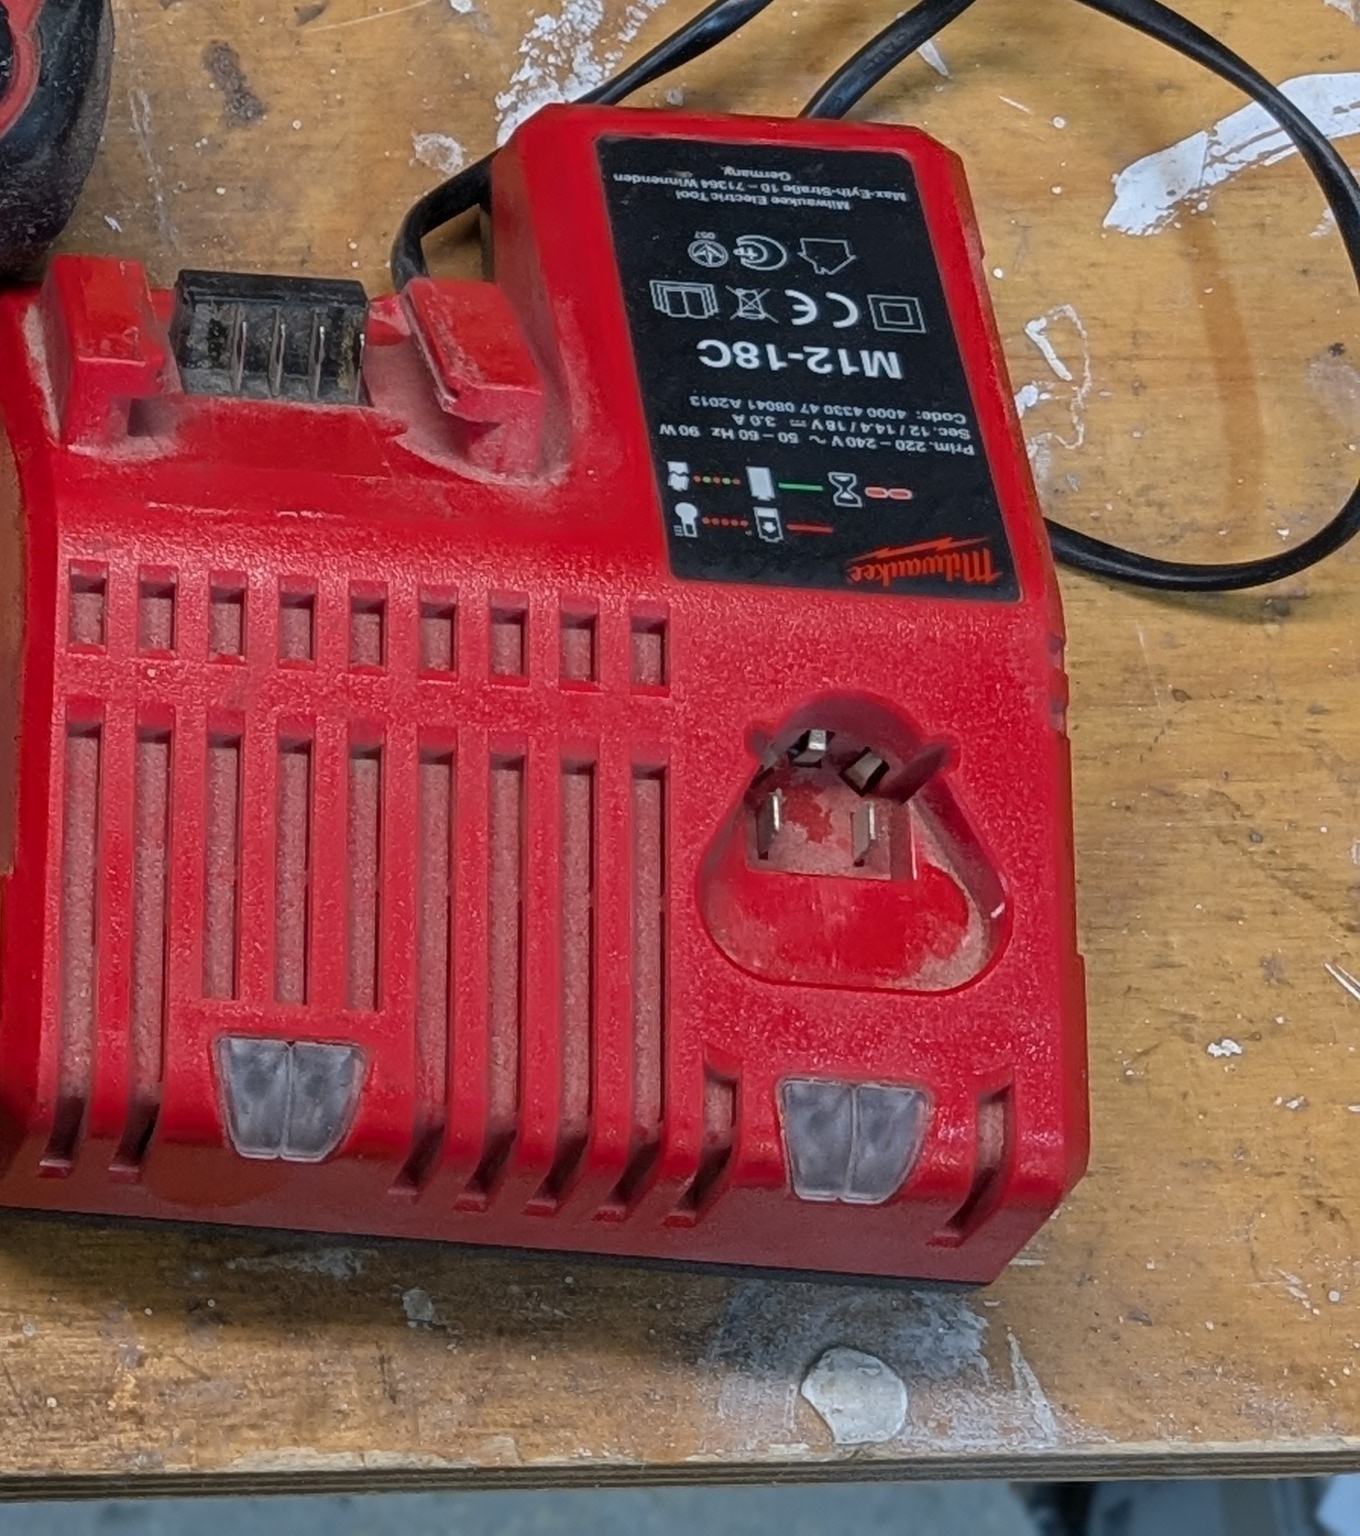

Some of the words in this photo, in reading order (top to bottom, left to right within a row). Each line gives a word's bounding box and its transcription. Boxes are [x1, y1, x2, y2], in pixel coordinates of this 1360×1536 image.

[613, 172, 699, 188] Winnenden
[675, 190, 709, 202] Tool
[710, 192, 768, 205] Electric
[771, 196, 850, 211] Milwaukee
[696, 339, 904, 380] M12-18C
[800, 403, 820, 414] 47
[823, 404, 864, 416] 4330
[866, 407, 907, 420] 4000
[731, 413, 746, 425] A
[749, 414, 777, 427] 3.0
[916, 410, 967, 425] Code:
[710, 427, 735, 440] Hz
[739, 429, 760, 441] 60
[860, 422, 896, 435] 14.4
[909, 424, 930, 437] 12
[932, 426, 972, 440] Sec.
[778, 431, 799, 444] 50
[895, 439, 928, 453] 220
[929, 442, 976, 456] Prim.
[850, 548, 1002, 587] Milwaukee
